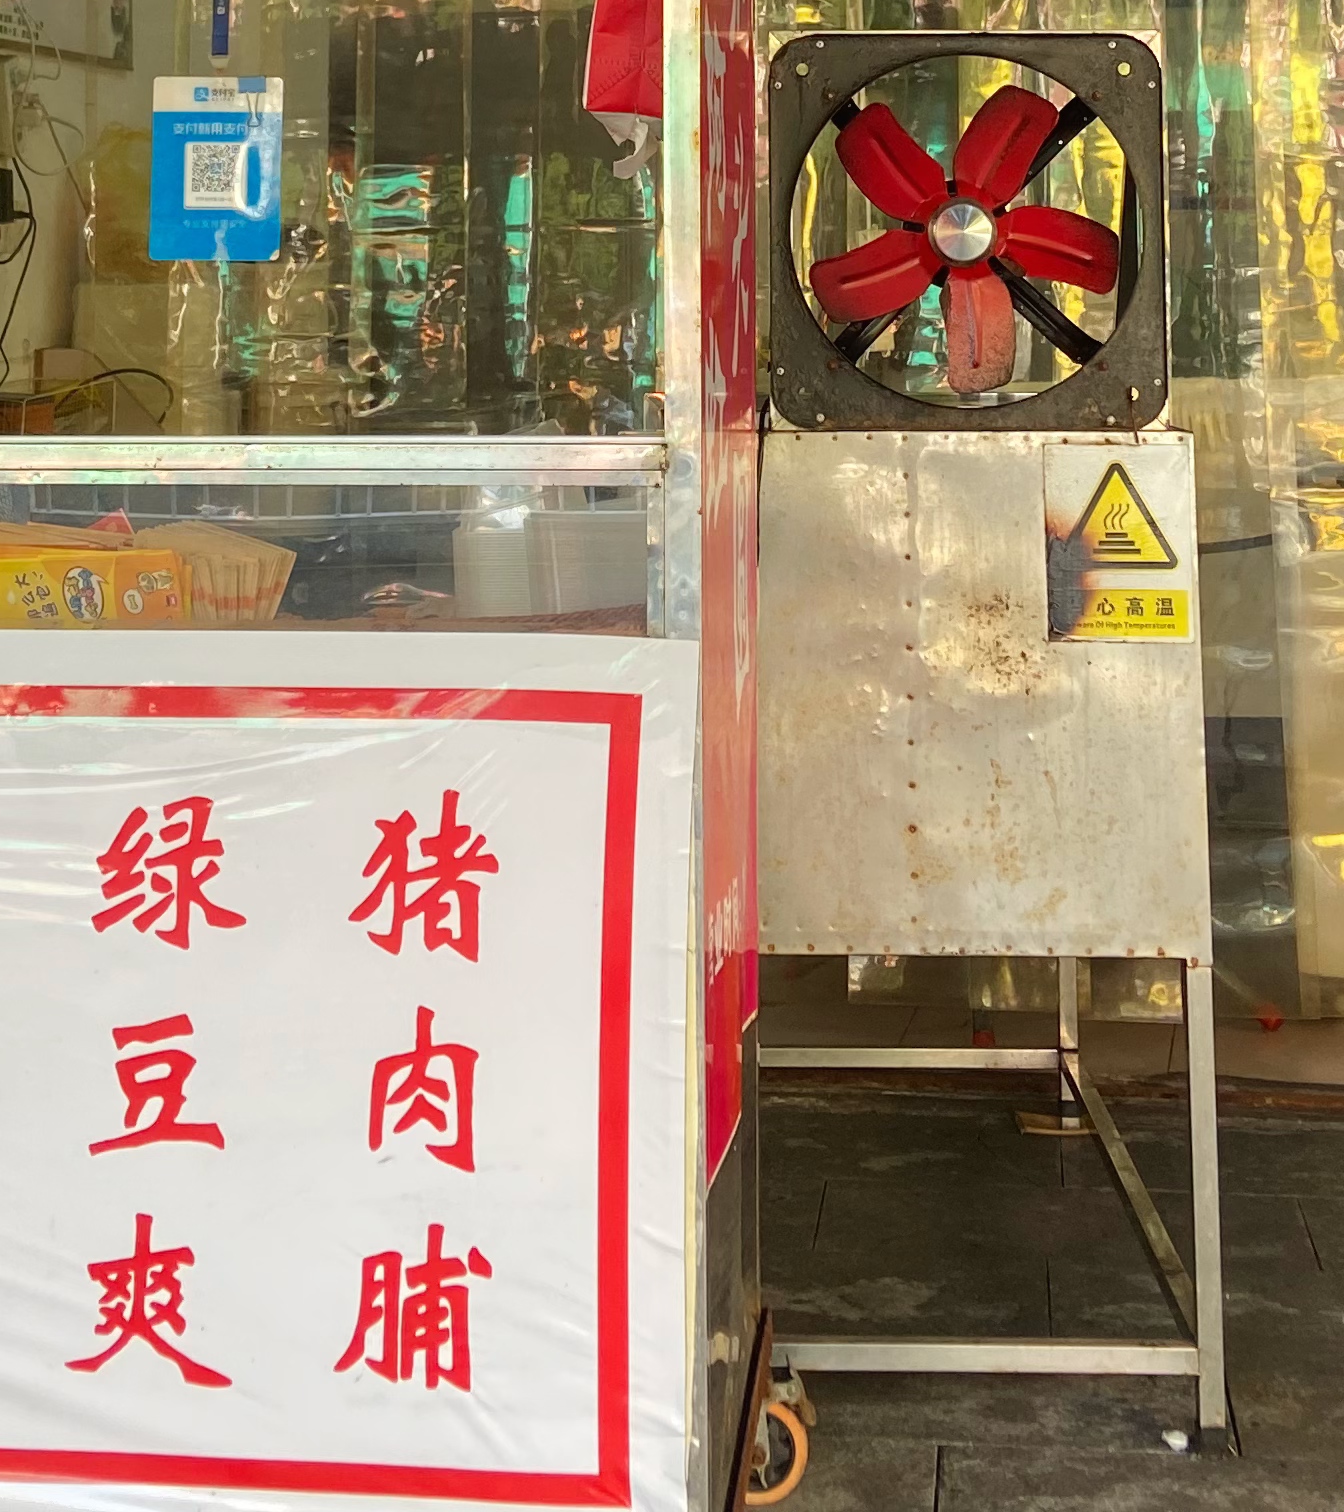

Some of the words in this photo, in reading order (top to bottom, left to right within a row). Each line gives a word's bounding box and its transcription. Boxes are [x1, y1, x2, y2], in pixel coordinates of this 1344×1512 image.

[1081, 597, 1175, 617] 心高温
[1105, 621, 1123, 631] High
[1124, 621, 1176, 631] Temperatures
[64, 796, 247, 1388] 绿豆爽
[333, 789, 500, 1393] 猪肉脯
